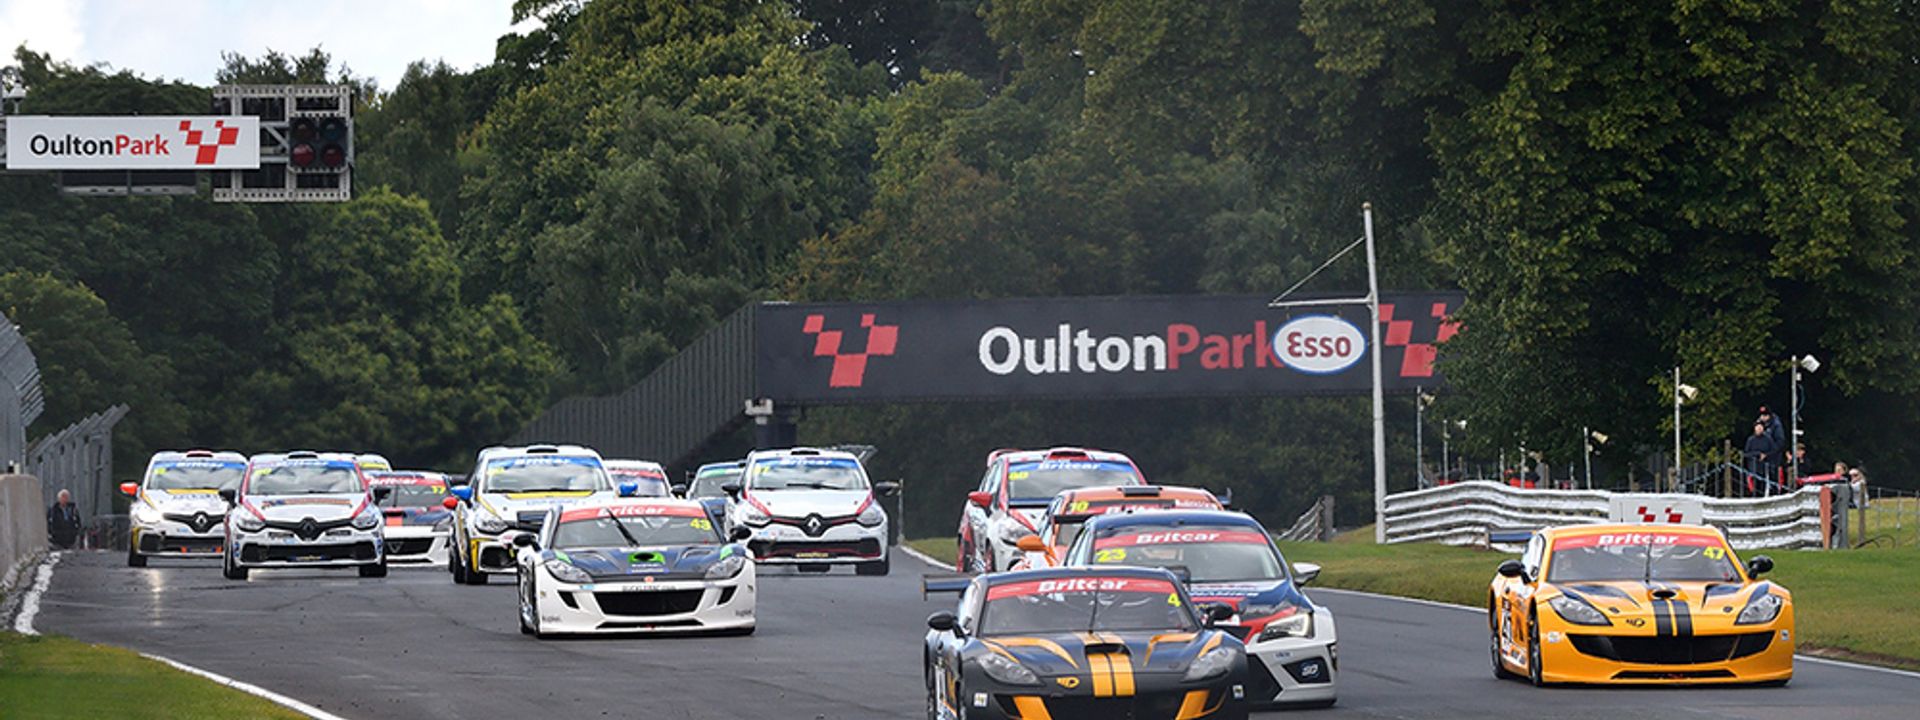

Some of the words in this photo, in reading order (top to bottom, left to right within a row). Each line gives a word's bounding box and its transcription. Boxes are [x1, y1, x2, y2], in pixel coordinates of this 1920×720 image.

[29, 133, 170, 156] OultonPark
[1287, 331, 1352, 359] Esso
[1036, 460, 1102, 472] Britcar
[596, 504, 667, 517] Britcar
[1069, 501, 1090, 513] 10
[1135, 531, 1221, 545] Britcar
[1597, 533, 1680, 546] Britcar
[1096, 548, 1128, 563] 23
[1702, 546, 1726, 560] 47
[1037, 577, 1129, 593] Britcar
[1167, 592, 1182, 608] 4
